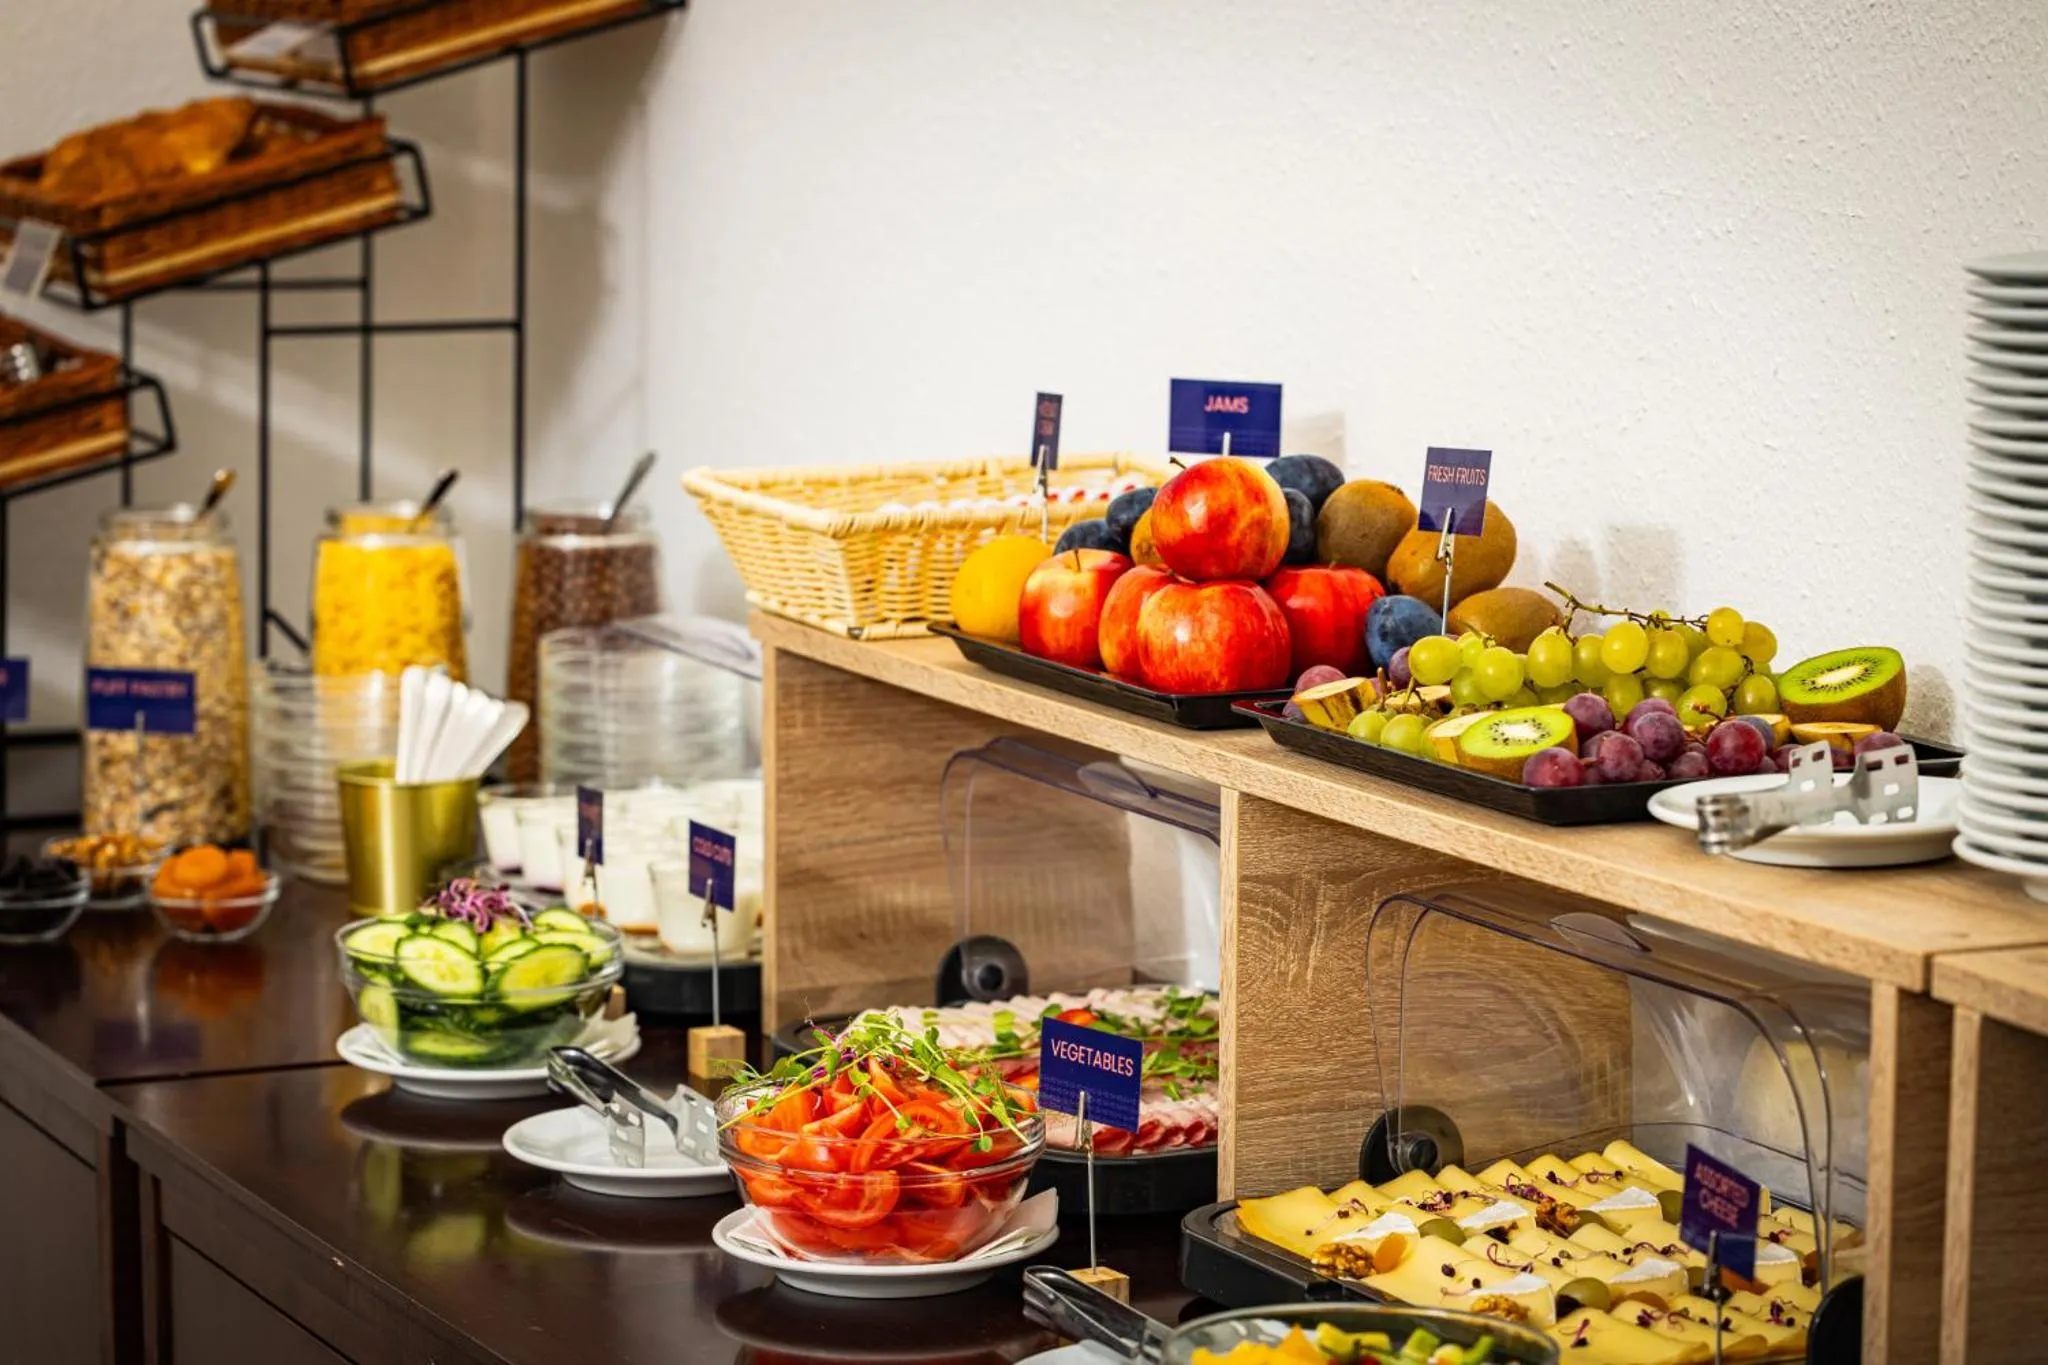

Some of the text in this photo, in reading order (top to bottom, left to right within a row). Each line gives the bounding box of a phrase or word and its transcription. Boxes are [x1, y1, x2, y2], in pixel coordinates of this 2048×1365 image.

[1204, 395, 1248, 414] JAMS
[1428, 464, 1486, 485] FRESH FRUITS
[1051, 1038, 1134, 1076] VEGETABLES
[1699, 1188, 1738, 1228] CHEESE
